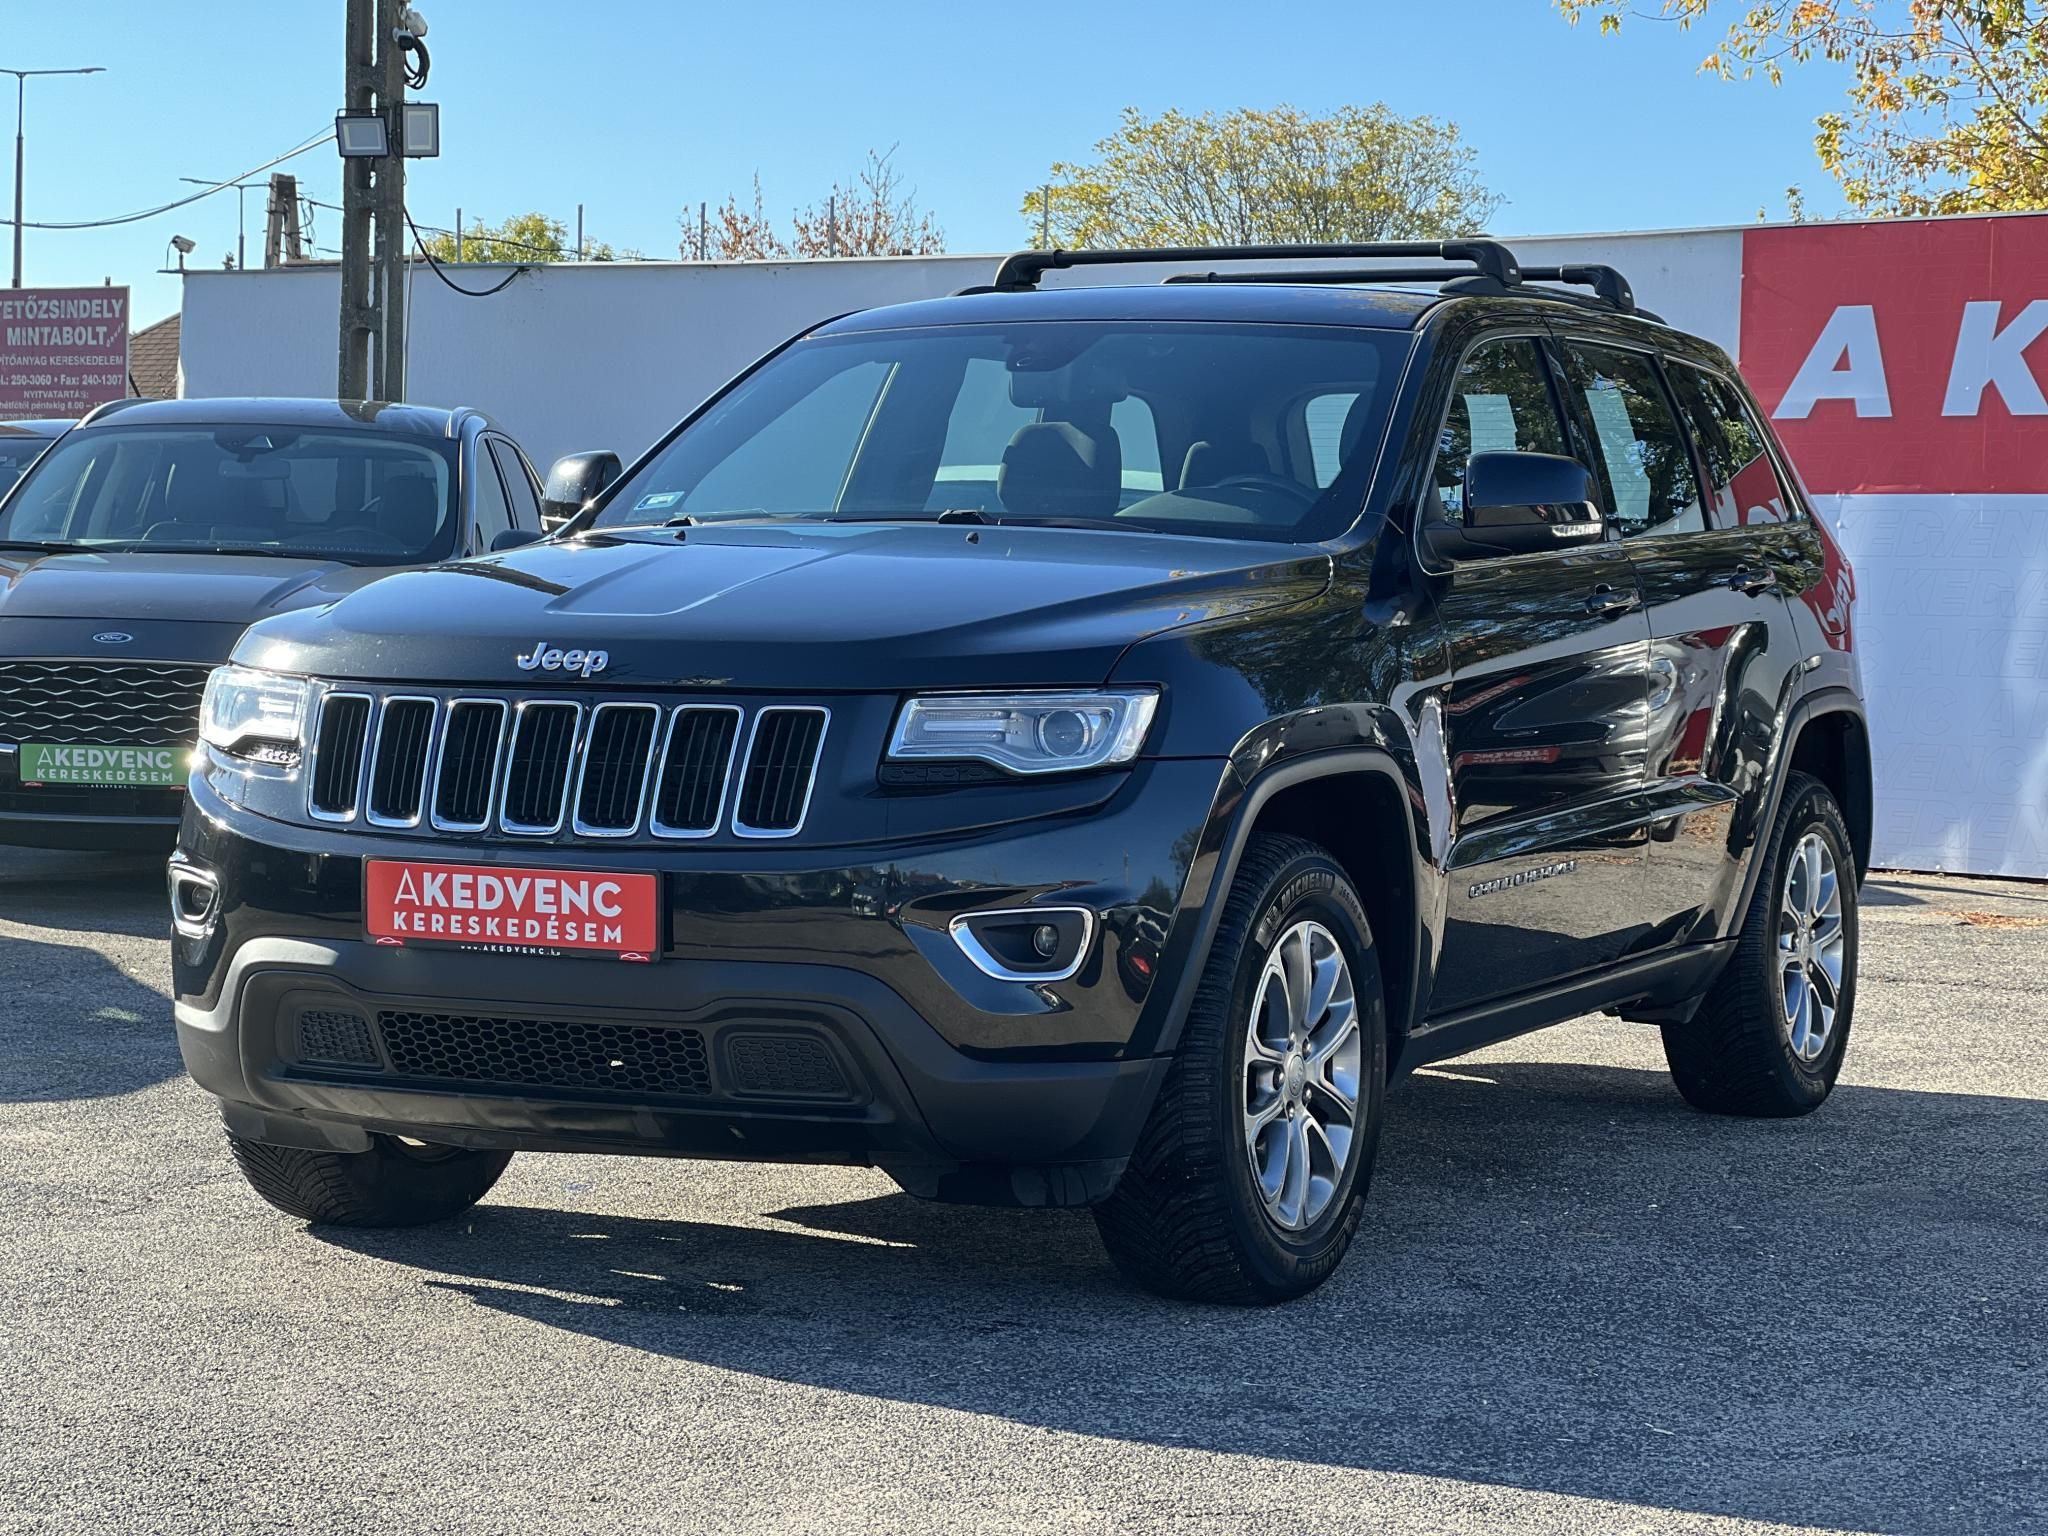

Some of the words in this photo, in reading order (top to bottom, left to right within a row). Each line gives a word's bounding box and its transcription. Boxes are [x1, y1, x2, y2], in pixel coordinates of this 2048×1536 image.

[0, 295, 123, 319] ETŐZSINDELY
[7, 326, 107, 346] MINTABOLT
[0, 354, 47, 366] ÍTŐANYAG
[50, 355, 123, 366] KERESKEDELEM
[11, 374, 51, 385] 250-3060
[60, 374, 79, 385] Fax:
[82, 374, 122, 385] 240-1307
[517, 642, 609, 678] Jeep
[37, 747, 172, 769] AKEDVENC
[37, 768, 173, 782] KERESKEDÉSEM
[394, 868, 622, 917] AKEDVENC
[1281, 872, 1333, 912] MICHELIN
[394, 911, 622, 944] KERESKEDÉSEM
